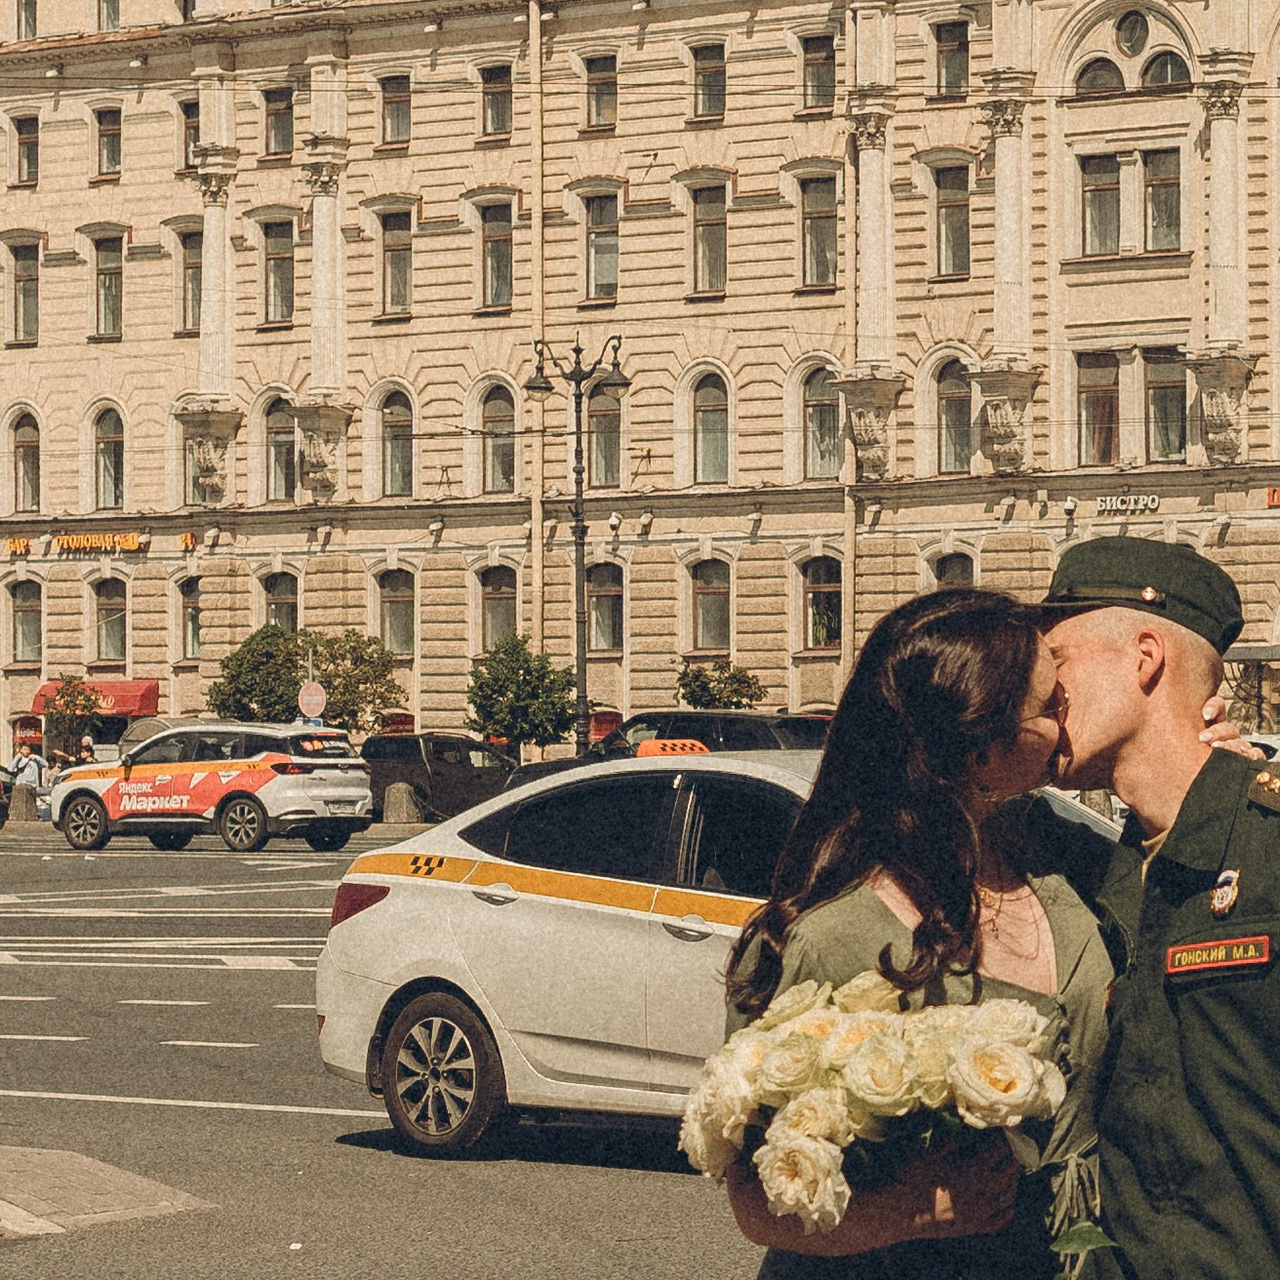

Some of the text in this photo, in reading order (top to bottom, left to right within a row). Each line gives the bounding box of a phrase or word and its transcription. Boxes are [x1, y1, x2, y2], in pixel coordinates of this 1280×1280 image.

[1096, 494, 1160, 511] БИСТРО
[118, 781, 153, 795] Яндекс
[119, 794, 190, 813] Маркет
[1232, 943, 1260, 960] М.А.
